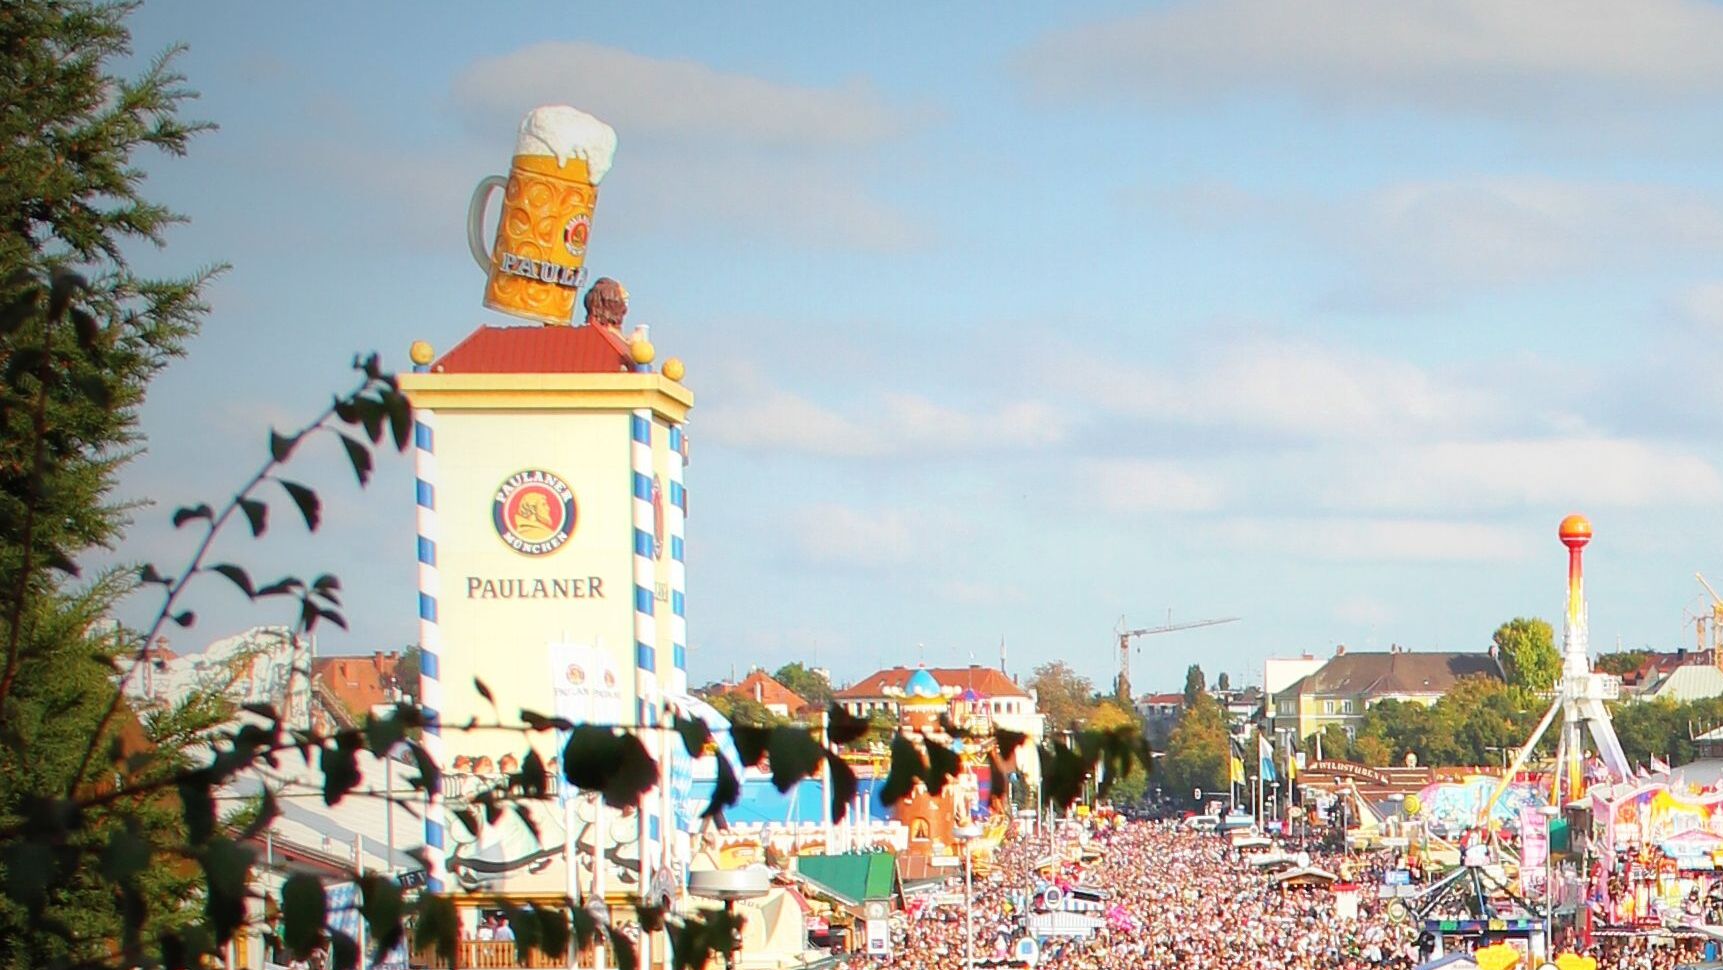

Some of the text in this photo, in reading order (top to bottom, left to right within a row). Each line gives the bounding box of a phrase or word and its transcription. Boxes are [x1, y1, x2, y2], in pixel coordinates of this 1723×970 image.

[495, 470, 573, 504] PAULANER
[502, 530, 568, 555] MÜNCHEN
[466, 576, 605, 600] PAULANER
